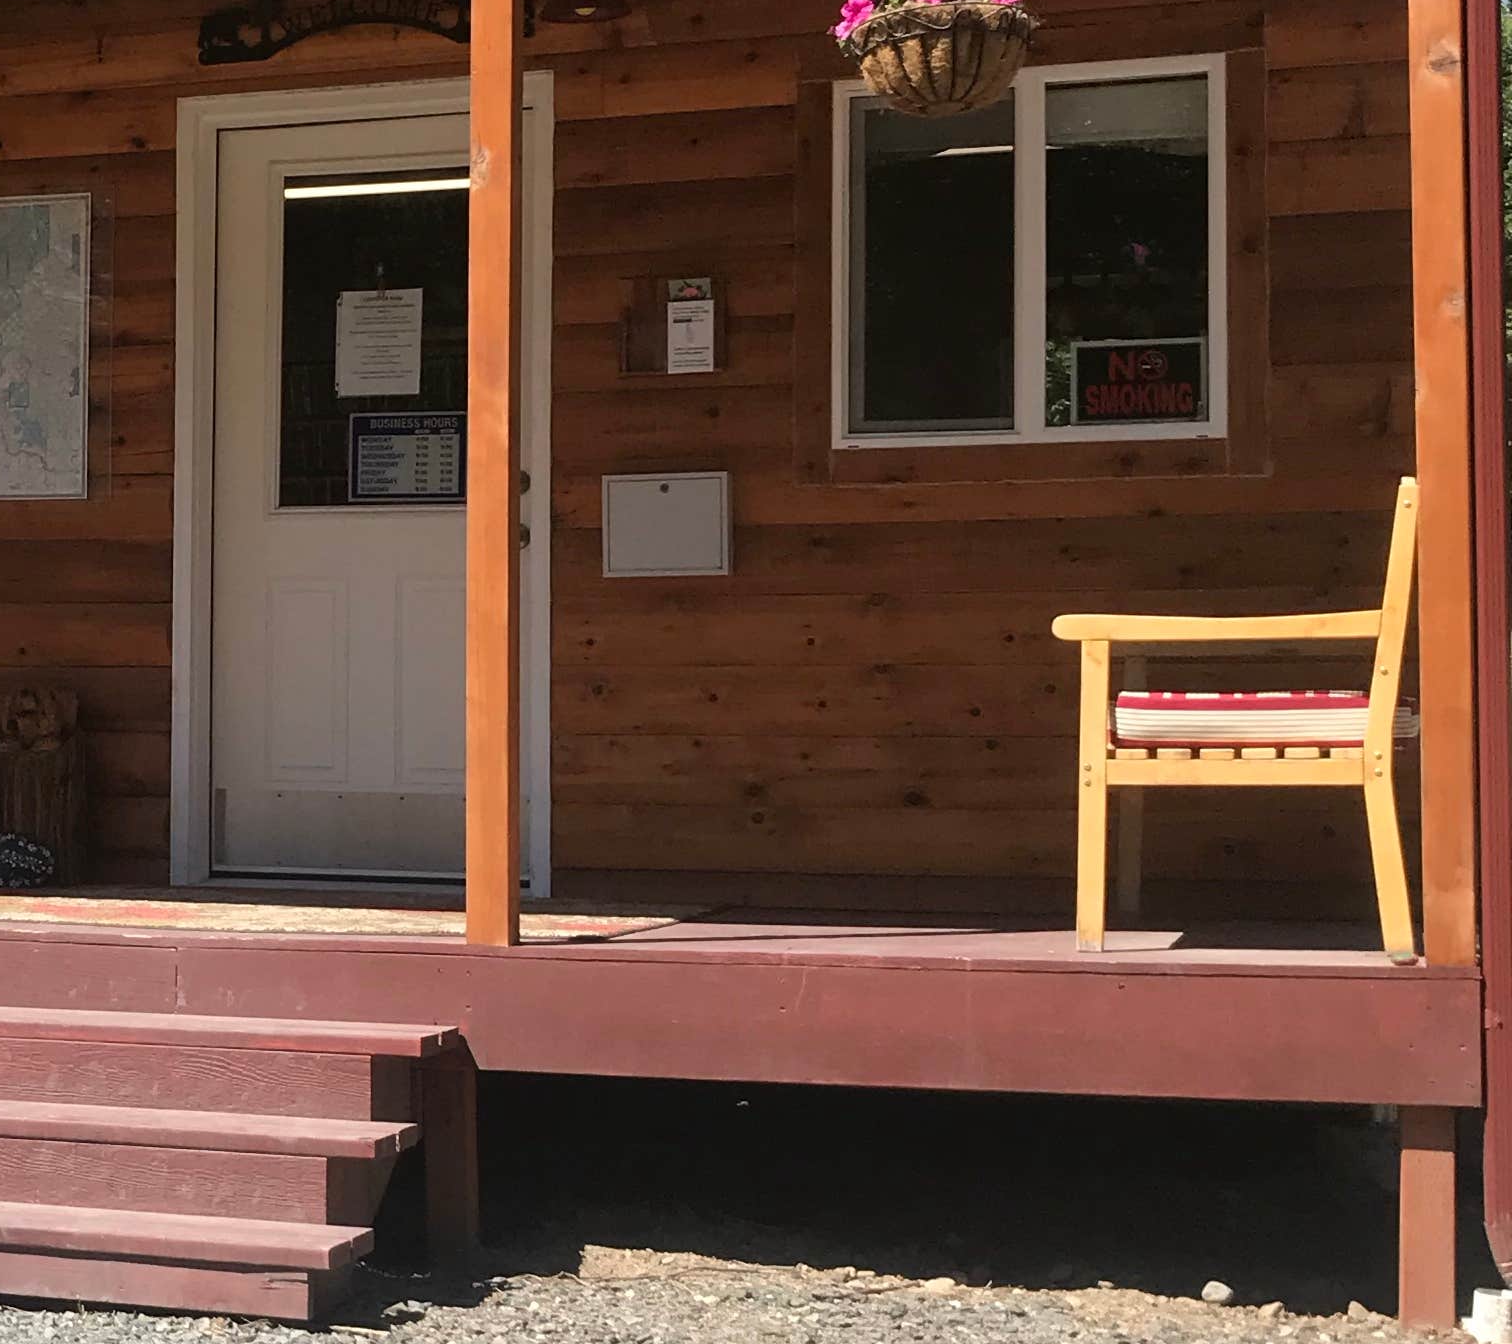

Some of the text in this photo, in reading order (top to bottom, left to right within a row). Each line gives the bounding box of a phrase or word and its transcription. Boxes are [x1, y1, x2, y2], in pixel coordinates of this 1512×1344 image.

[1108, 350, 1168, 382] NO
[1084, 383, 1193, 416] SMOKING
[370, 416, 458, 429] BUSINESS HOURS
